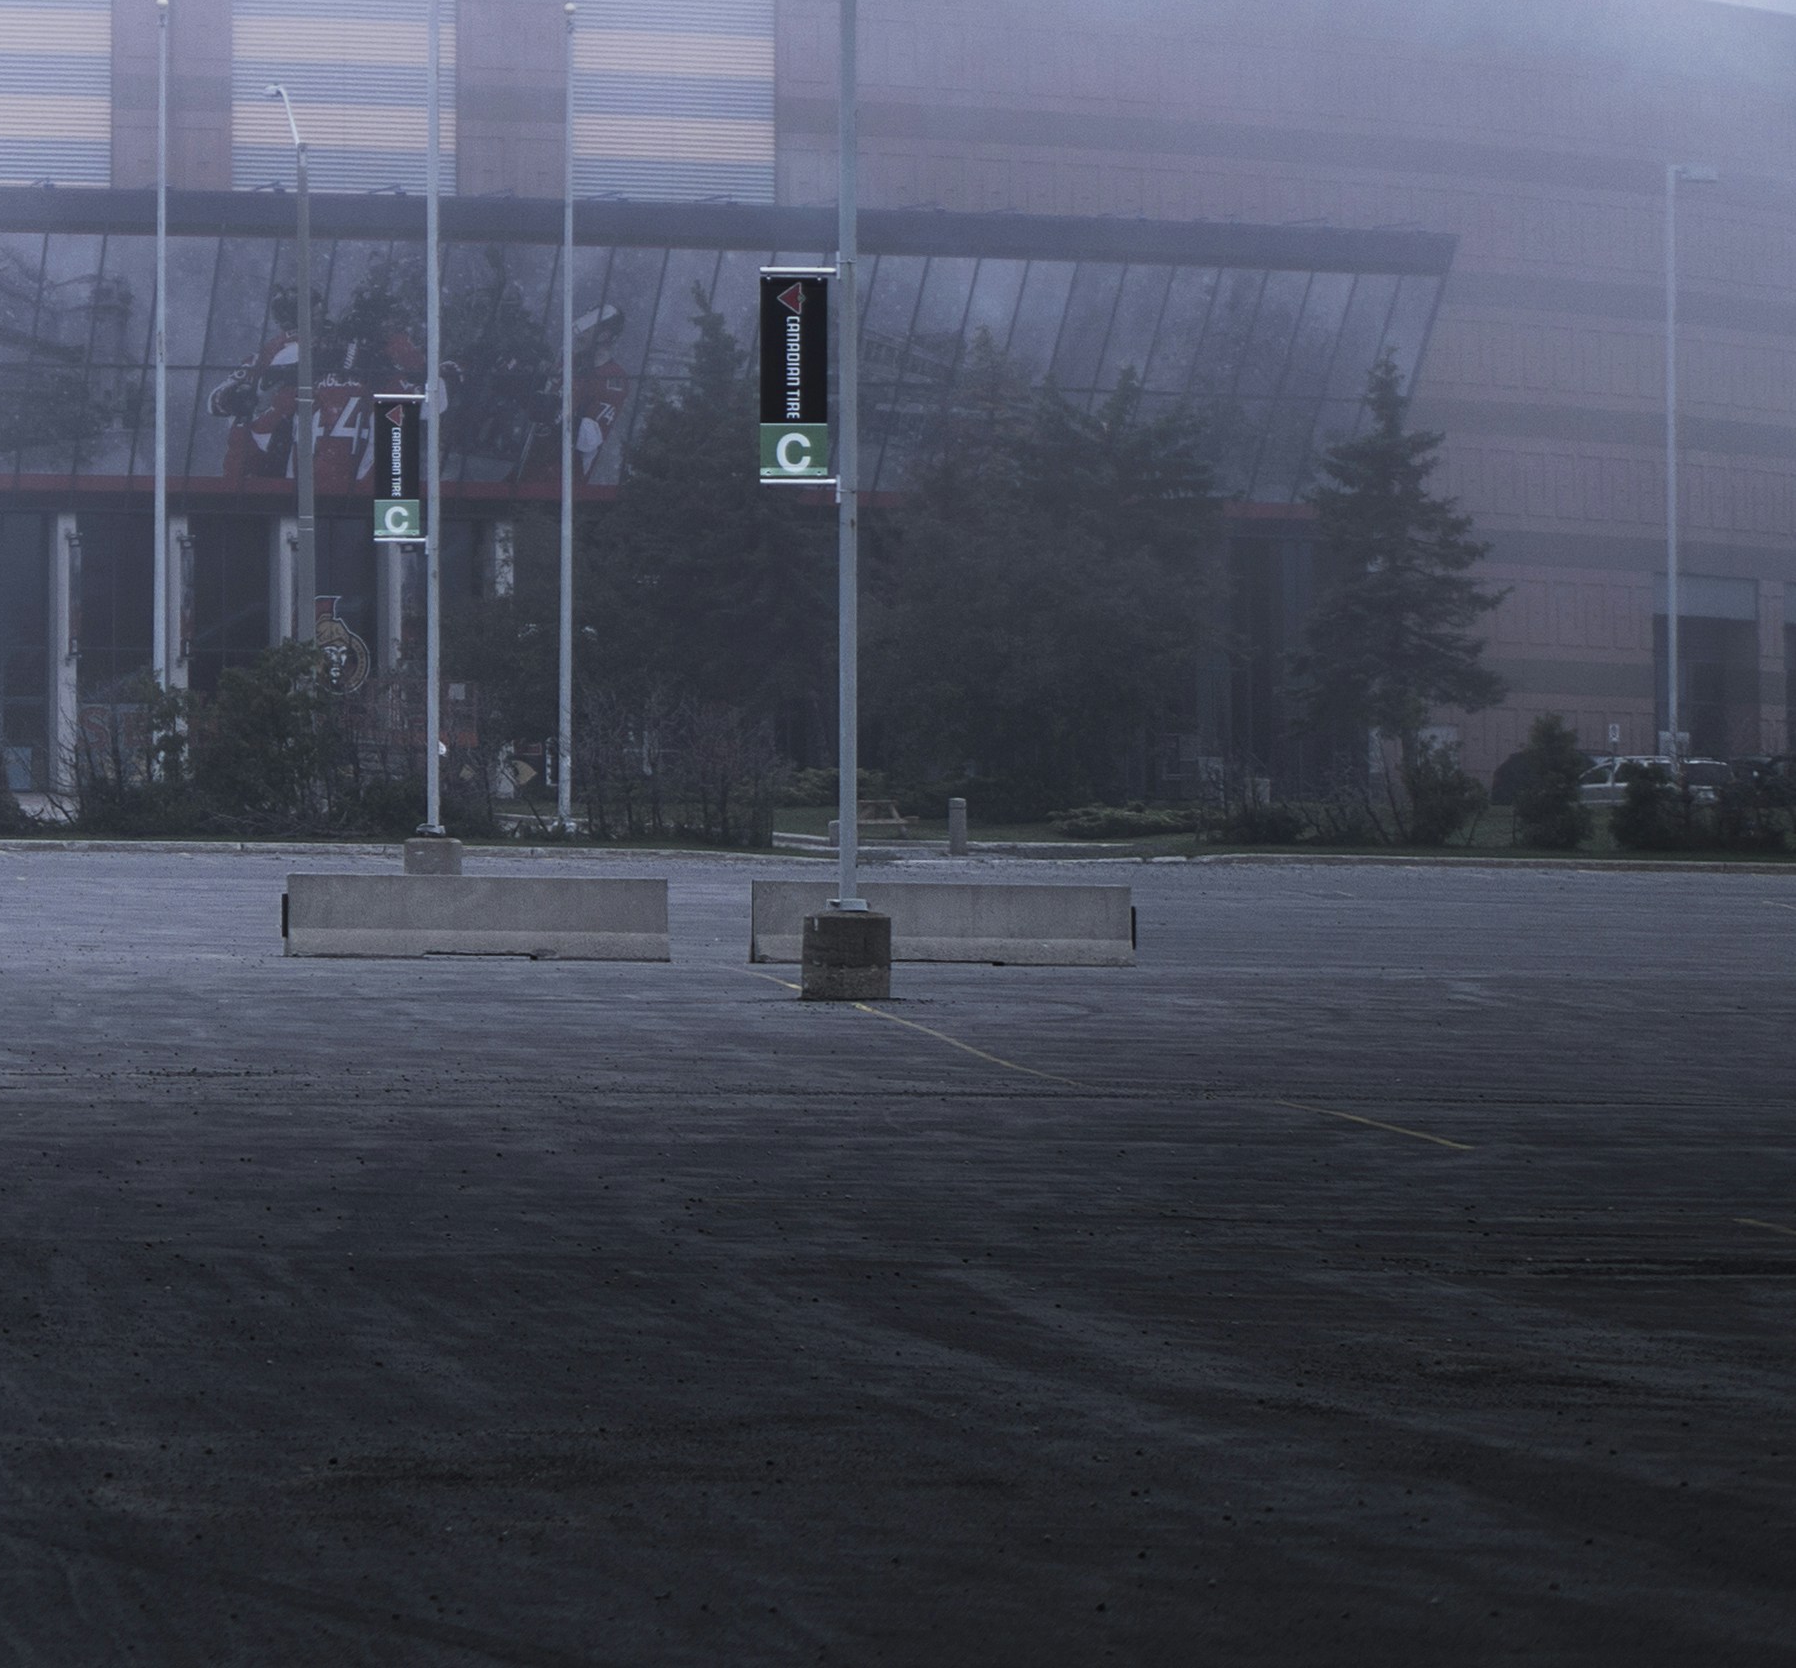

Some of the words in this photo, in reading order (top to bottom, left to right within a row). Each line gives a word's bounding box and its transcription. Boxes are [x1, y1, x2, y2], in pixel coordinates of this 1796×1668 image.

[786, 315, 801, 386] CANADIAN
[786, 388, 801, 419] TIRE
[390, 427, 402, 475] CANADIAN
[776, 432, 812, 473] C
[390, 476, 402, 498] TIRE
[384, 506, 410, 534] C
